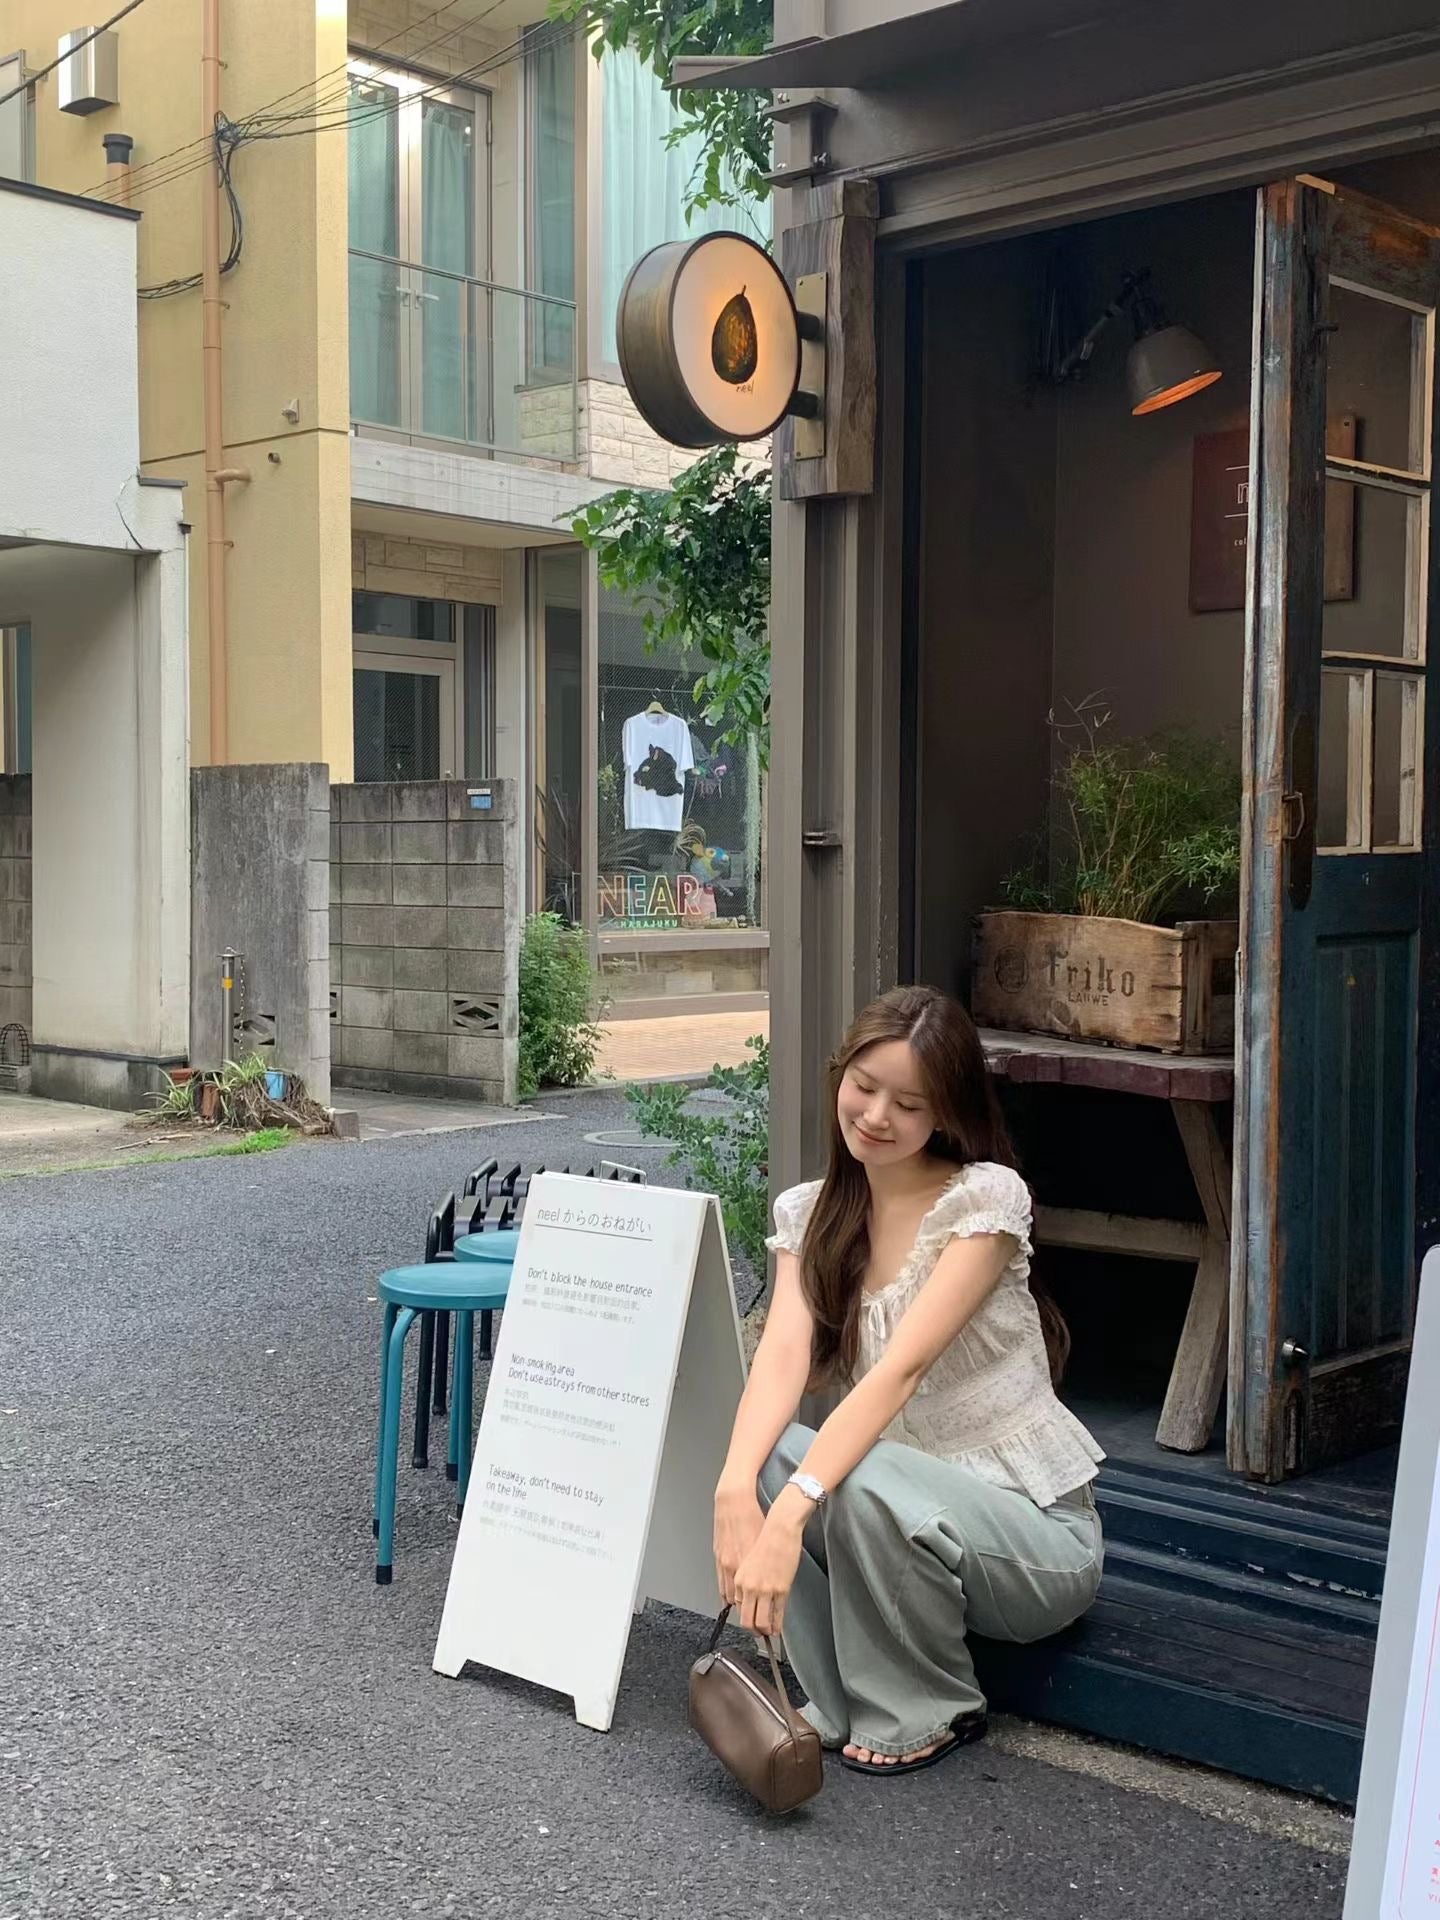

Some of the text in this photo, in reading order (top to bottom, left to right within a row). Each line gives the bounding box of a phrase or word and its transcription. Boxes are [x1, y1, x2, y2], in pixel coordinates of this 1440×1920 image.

[598, 875, 702, 917] NEAR
[537, 1208, 652, 1233] neel からのおねがい
[527, 1267, 548, 1280] Don't
[550, 1271, 572, 1285] block
[573, 1275, 587, 1288] the
[589, 1278, 613, 1292] house
[615, 1283, 653, 1298] entrance
[508, 1366, 529, 1382] Don't
[576, 1381, 597, 1397] from
[597, 1385, 620, 1401] other
[621, 1392, 651, 1408] stores
[486, 1481, 528, 1500] on the line
[529, 1476, 550, 1490] don't
[551, 1480, 571, 1496] need
[573, 1485, 583, 1498] to
[585, 1490, 605, 1507] stay
